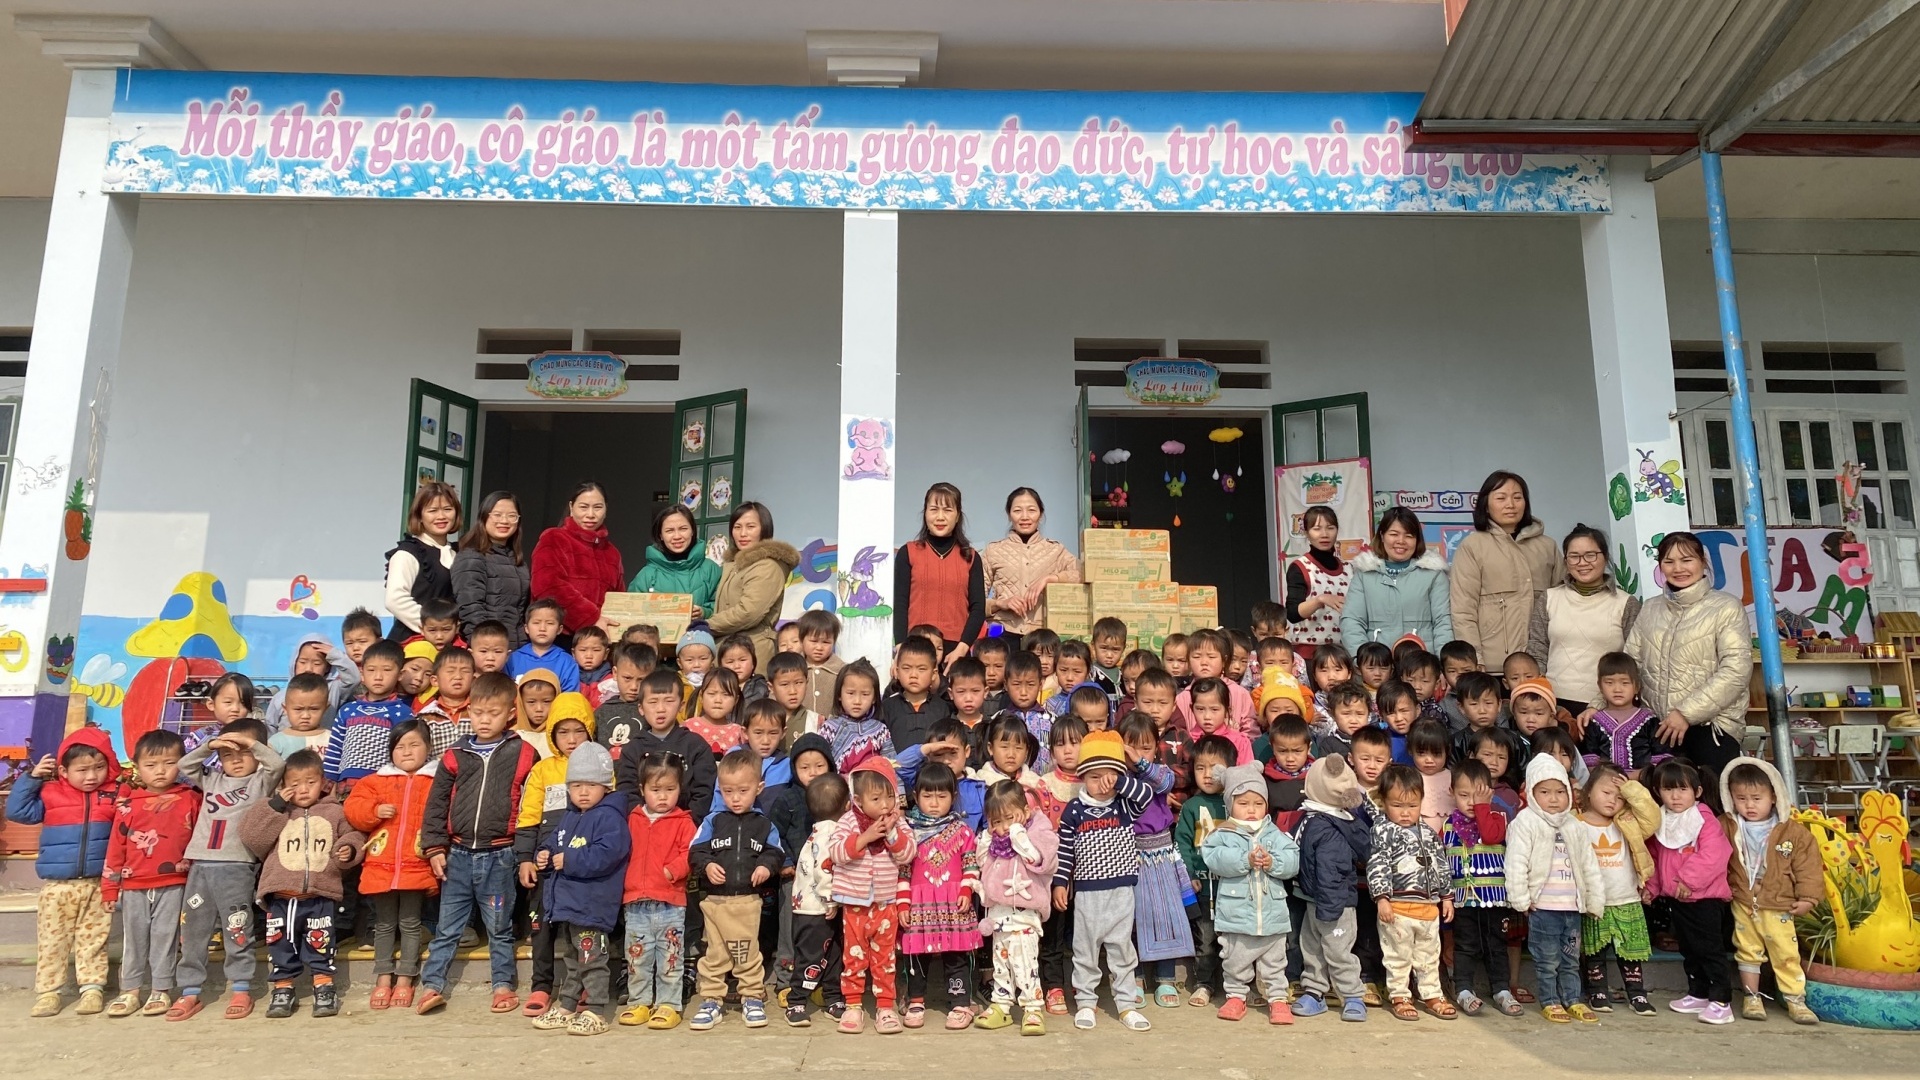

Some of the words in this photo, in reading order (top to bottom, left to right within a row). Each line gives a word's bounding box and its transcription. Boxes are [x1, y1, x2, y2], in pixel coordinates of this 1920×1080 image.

[178, 87, 259, 158] Mỗi
[269, 92, 363, 172] thầy
[367, 105, 464, 175] giáo,
[478, 106, 524, 163] cô
[532, 109, 619, 178] giáo
[629, 111, 667, 166] là
[677, 113, 761, 184] một
[772, 105, 848, 171] tấm
[857, 123, 982, 186] gương
[991, 116, 1061, 190] đạo
[1072, 117, 1154, 188] đức,
[1168, 126, 1216, 191] tự
[1222, 123, 1293, 191] học
[1304, 120, 1349, 176] và
[1400, 494, 1429, 506] huynh
[710, 836, 732, 850] Kisd
[750, 837, 763, 852] Tin
